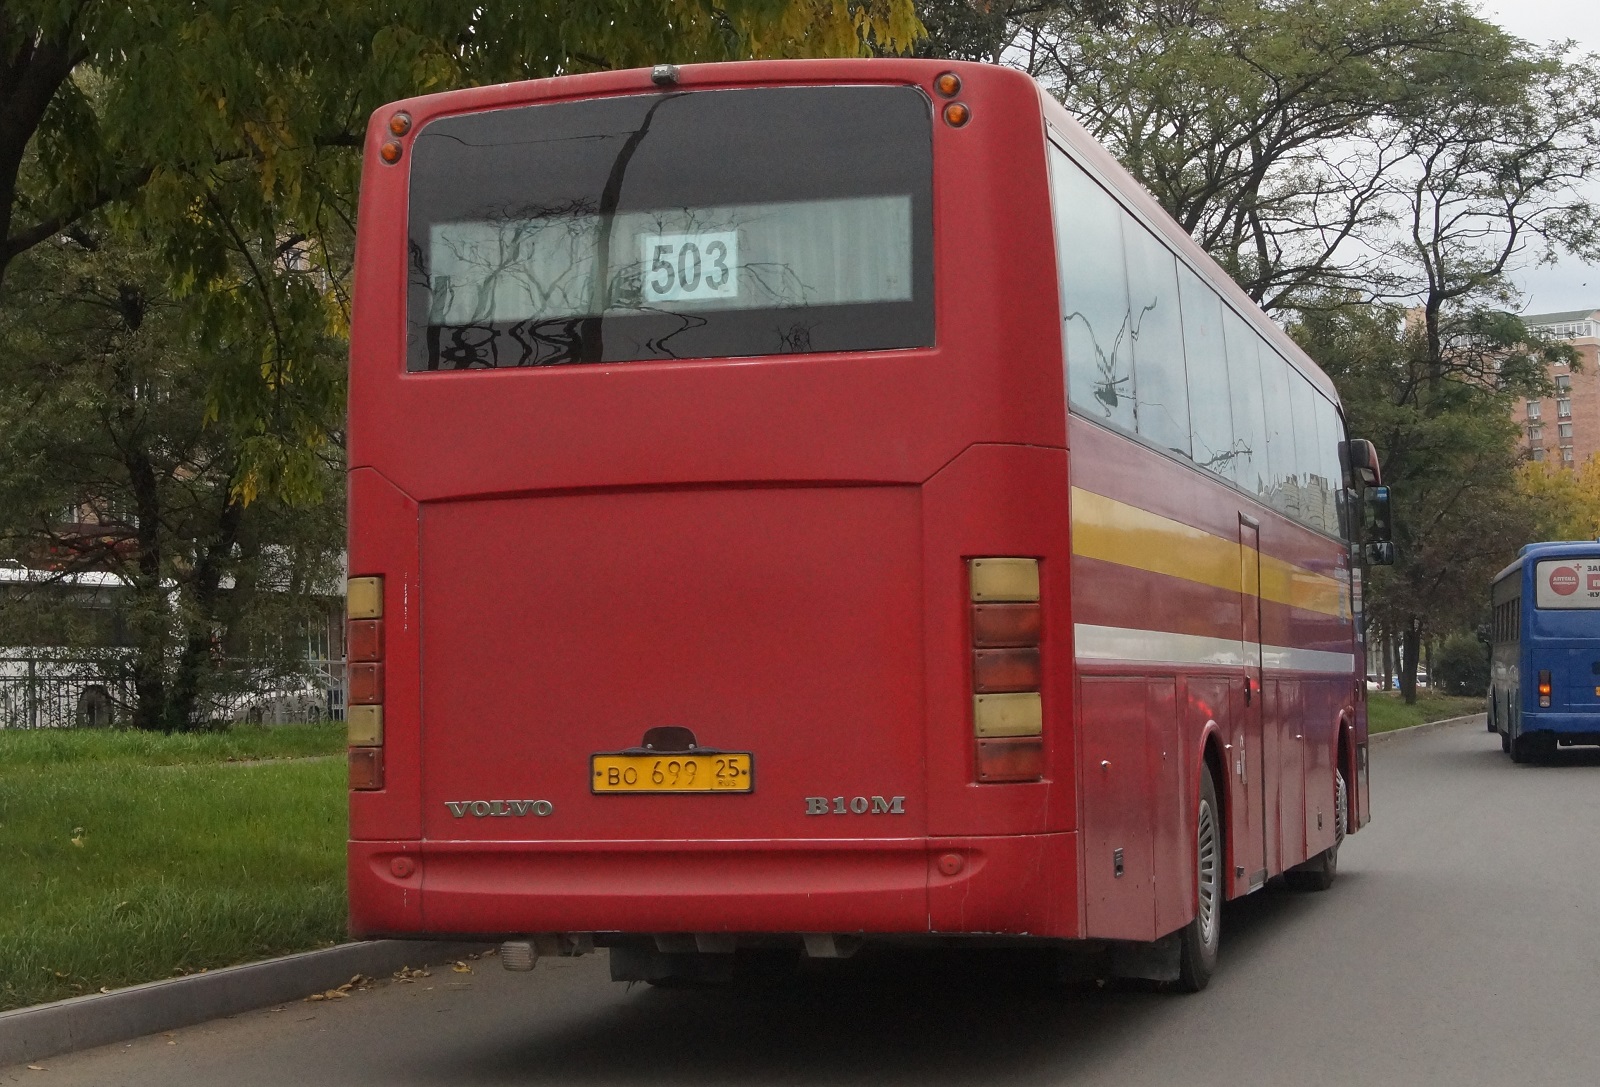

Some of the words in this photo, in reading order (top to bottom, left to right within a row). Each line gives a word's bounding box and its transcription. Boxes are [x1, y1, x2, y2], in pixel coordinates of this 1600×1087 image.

[651, 240, 729, 295] 503
[652, 760, 697, 785] 699
[715, 759, 739, 777] 25
[444, 800, 553, 818] VOLVO
[805, 796, 905, 815] B10M
